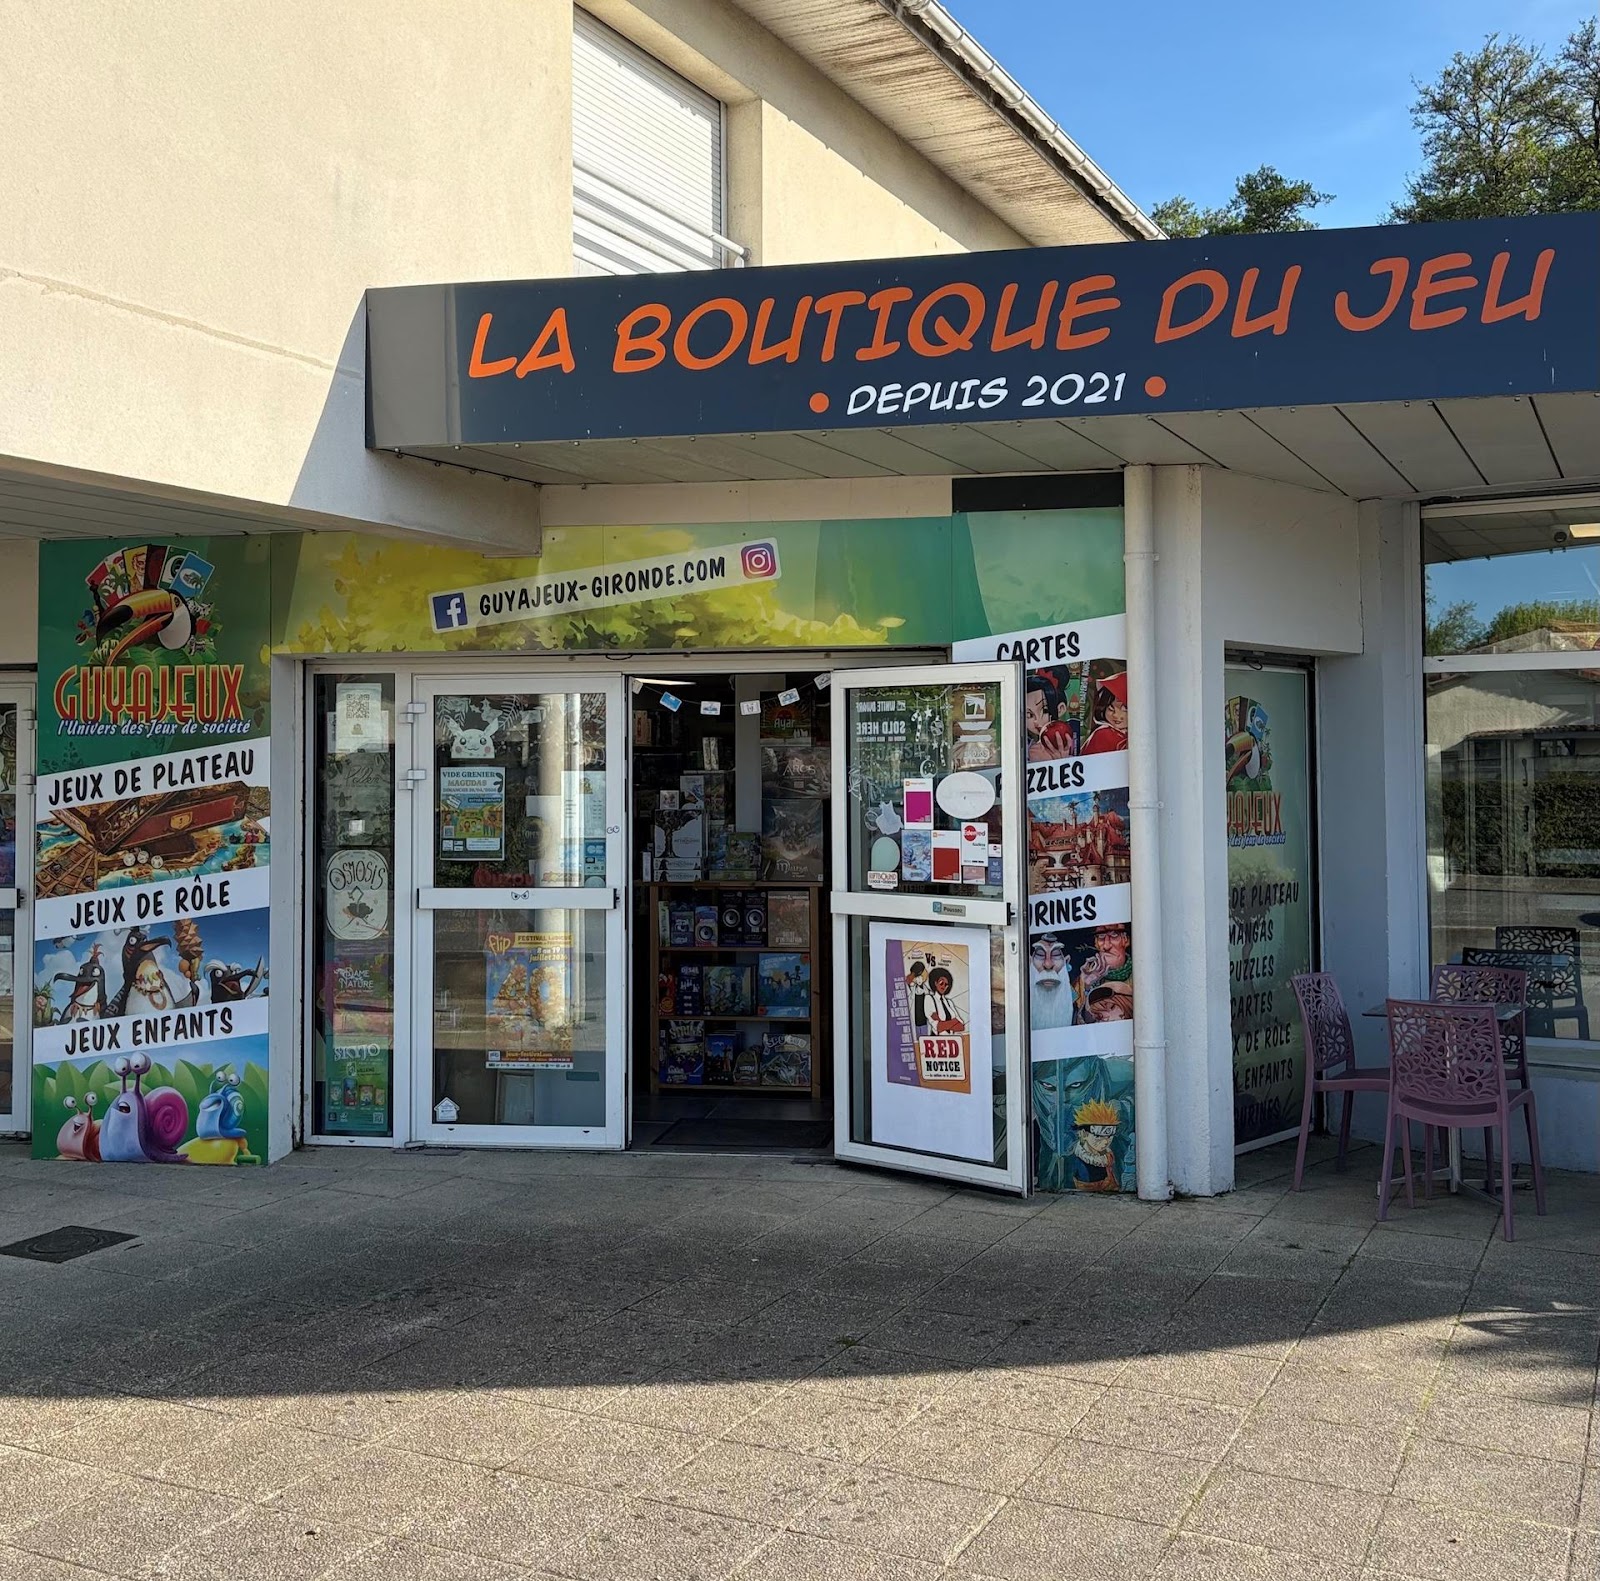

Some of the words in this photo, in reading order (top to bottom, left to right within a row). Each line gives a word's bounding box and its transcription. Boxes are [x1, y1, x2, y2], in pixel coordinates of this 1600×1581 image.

[469, 308, 574, 378] LA
[613, 275, 1120, 373] BOUTIQUE
[1155, 265, 1301, 342] DU
[1335, 249, 1555, 331] JEU
[847, 376, 1009, 416] DEPUIS
[1021, 371, 1126, 407] 2021
[479, 555, 726, 617] GUYAJEUX-GIRONDE.COM
[54, 664, 245, 725] GUYAJEUX
[58, 717, 117, 736] l'Univers
[121, 718, 145, 736] des
[182, 718, 199, 735] de
[202, 717, 252, 735] société
[49, 771, 104, 805] JEUX
[115, 766, 143, 795] DE
[153, 749, 255, 788] PLATEAU
[71, 896, 125, 929] JEUX
[137, 890, 164, 918] DE
[176, 873, 231, 911] RÔLE
[1232, 886, 1246, 910] DE
[1251, 881, 1299, 908] PLATEAU
[1230, 919, 1274, 946] MANGAS
[339, 978, 375, 989] NATURE
[1231, 990, 1273, 1020] CARTES
[65, 1023, 120, 1055] JEUX
[133, 1006, 234, 1048] ENFANTS
[1246, 1029, 1260, 1054] DE
[924, 1039, 960, 1059] RED
[926, 1061, 961, 1072] NOTICE
[1245, 1057, 1294, 1090] ENFANTS
